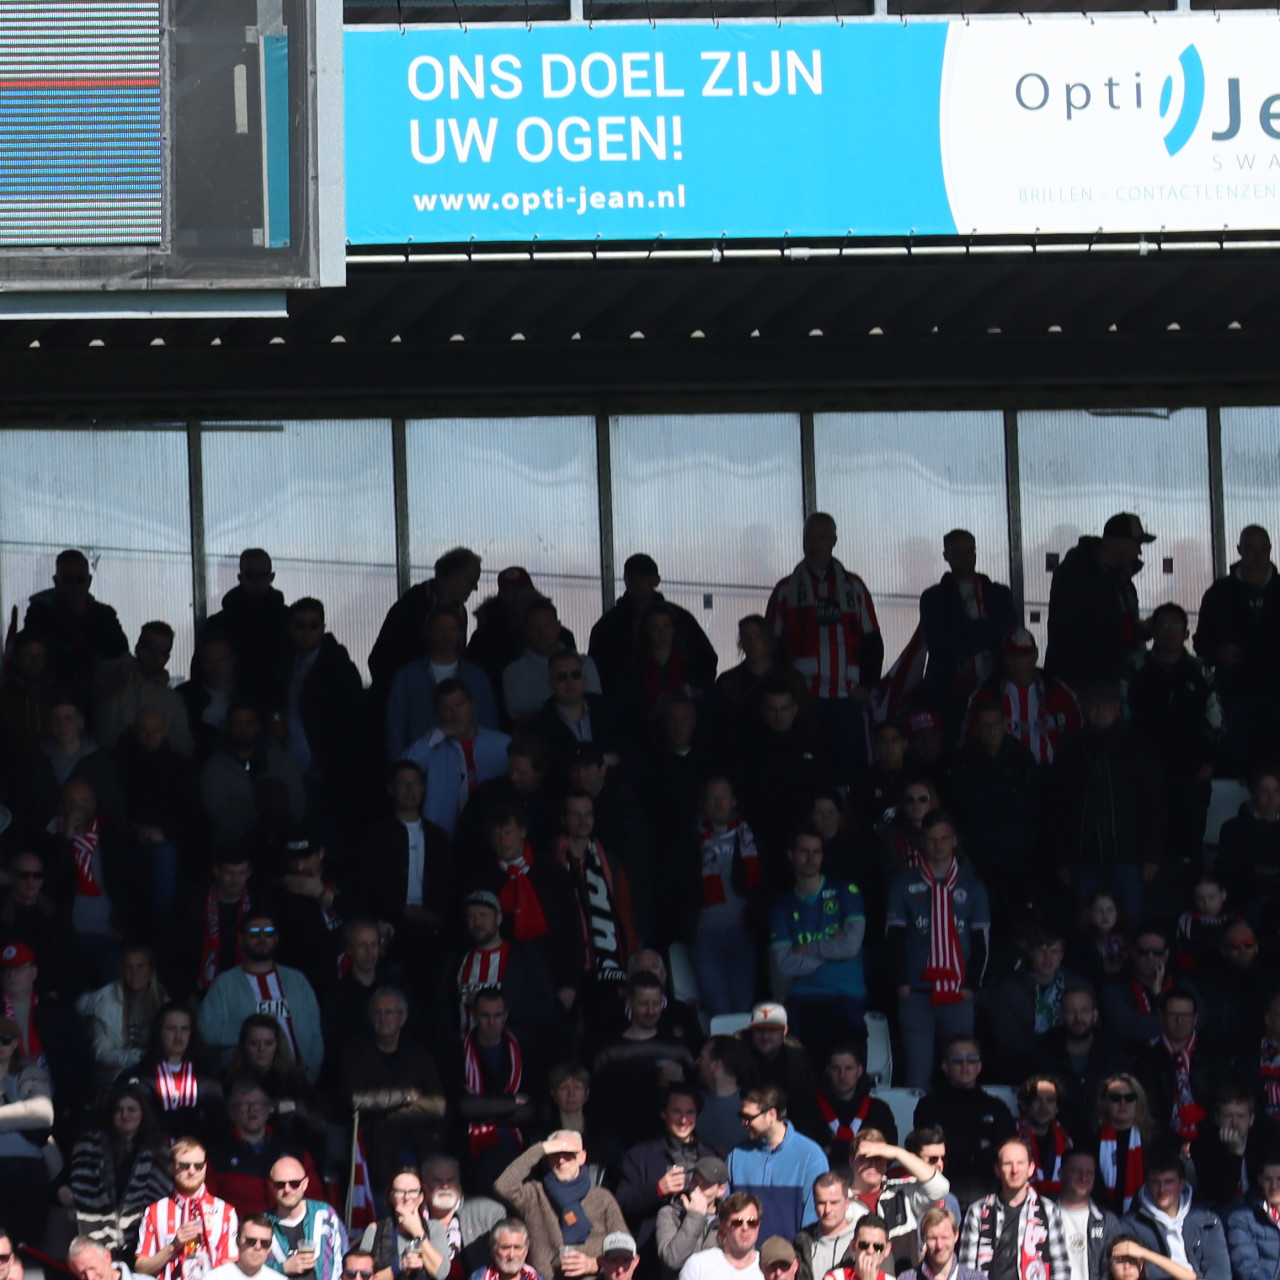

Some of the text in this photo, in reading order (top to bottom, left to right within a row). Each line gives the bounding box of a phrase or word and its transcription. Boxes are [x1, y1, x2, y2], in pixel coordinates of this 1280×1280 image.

[407, 49, 823, 101] ONS DOEL ZIJN
[1015, 72, 1142, 121] Opti
[410, 115, 683, 164] UW OGEN!
[413, 184, 686, 216] www.opti-jean.nl
[1018, 185, 1093, 203] BRILLEN
[1115, 183, 1277, 202] CONTACTLENZEN
